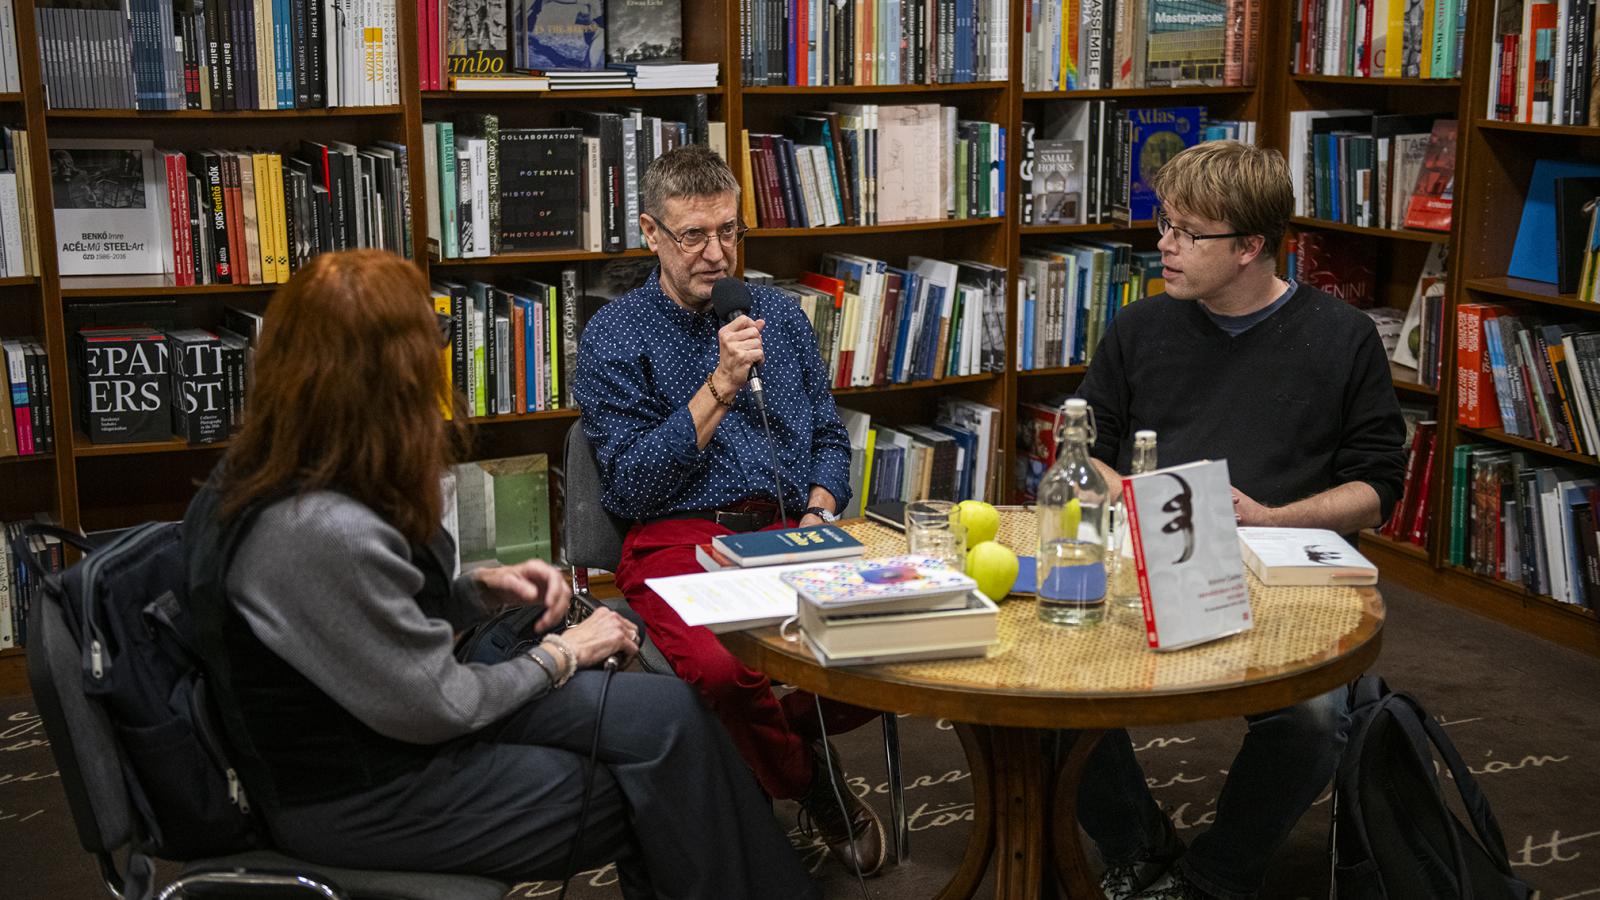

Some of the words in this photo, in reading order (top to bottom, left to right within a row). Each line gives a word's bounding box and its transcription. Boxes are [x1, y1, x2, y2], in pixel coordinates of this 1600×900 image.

[1155, 12, 1223, 25] Masterpieces
[1089, 0, 1102, 75] ASSEMBLE
[210, 42, 219, 64] Balla
[223, 43, 232, 65] Balla
[1138, 109, 1176, 124] Atlas
[487, 138, 497, 169] Congo
[625, 132, 635, 159] IT'S
[444, 146, 453, 173] CLAXTON
[461, 161, 469, 177] OUR
[1038, 163, 1075, 172] HOUSES
[1041, 154, 1072, 163] SMALL
[208, 166, 220, 184] IDŐK
[489, 170, 498, 195] Tales
[520, 169, 575, 177] POTENTIAL
[627, 164, 636, 185] ALL
[461, 179, 470, 205] TOWN
[628, 192, 637, 227] TRUE
[502, 230, 574, 238] PHOTOGRAPHY
[103, 242, 144, 251] STEEL-Art
[565, 296, 574, 338] SALGADO
[455, 296, 463, 362] MAPPLETHORPE
[88, 379, 161, 413] ERS
